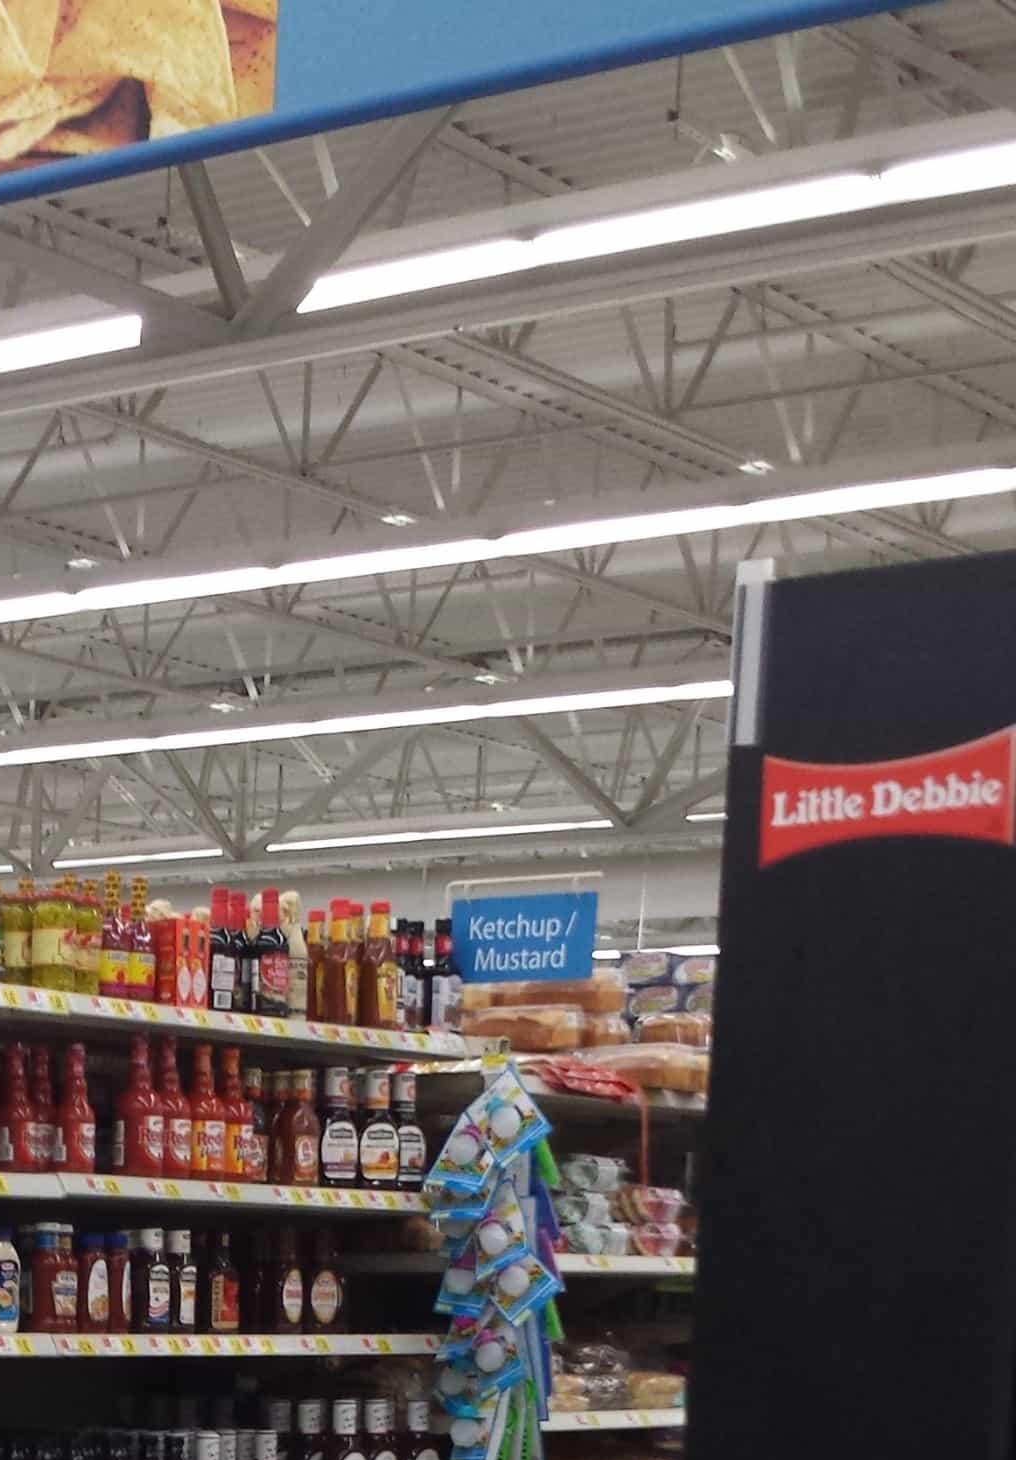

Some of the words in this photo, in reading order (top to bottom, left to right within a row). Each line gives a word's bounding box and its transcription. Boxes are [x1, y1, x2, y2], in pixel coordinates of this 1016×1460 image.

[771, 785, 865, 827] Little
[871, 771, 1003, 817] Debbie
[473, 943, 566, 972] Mustard
